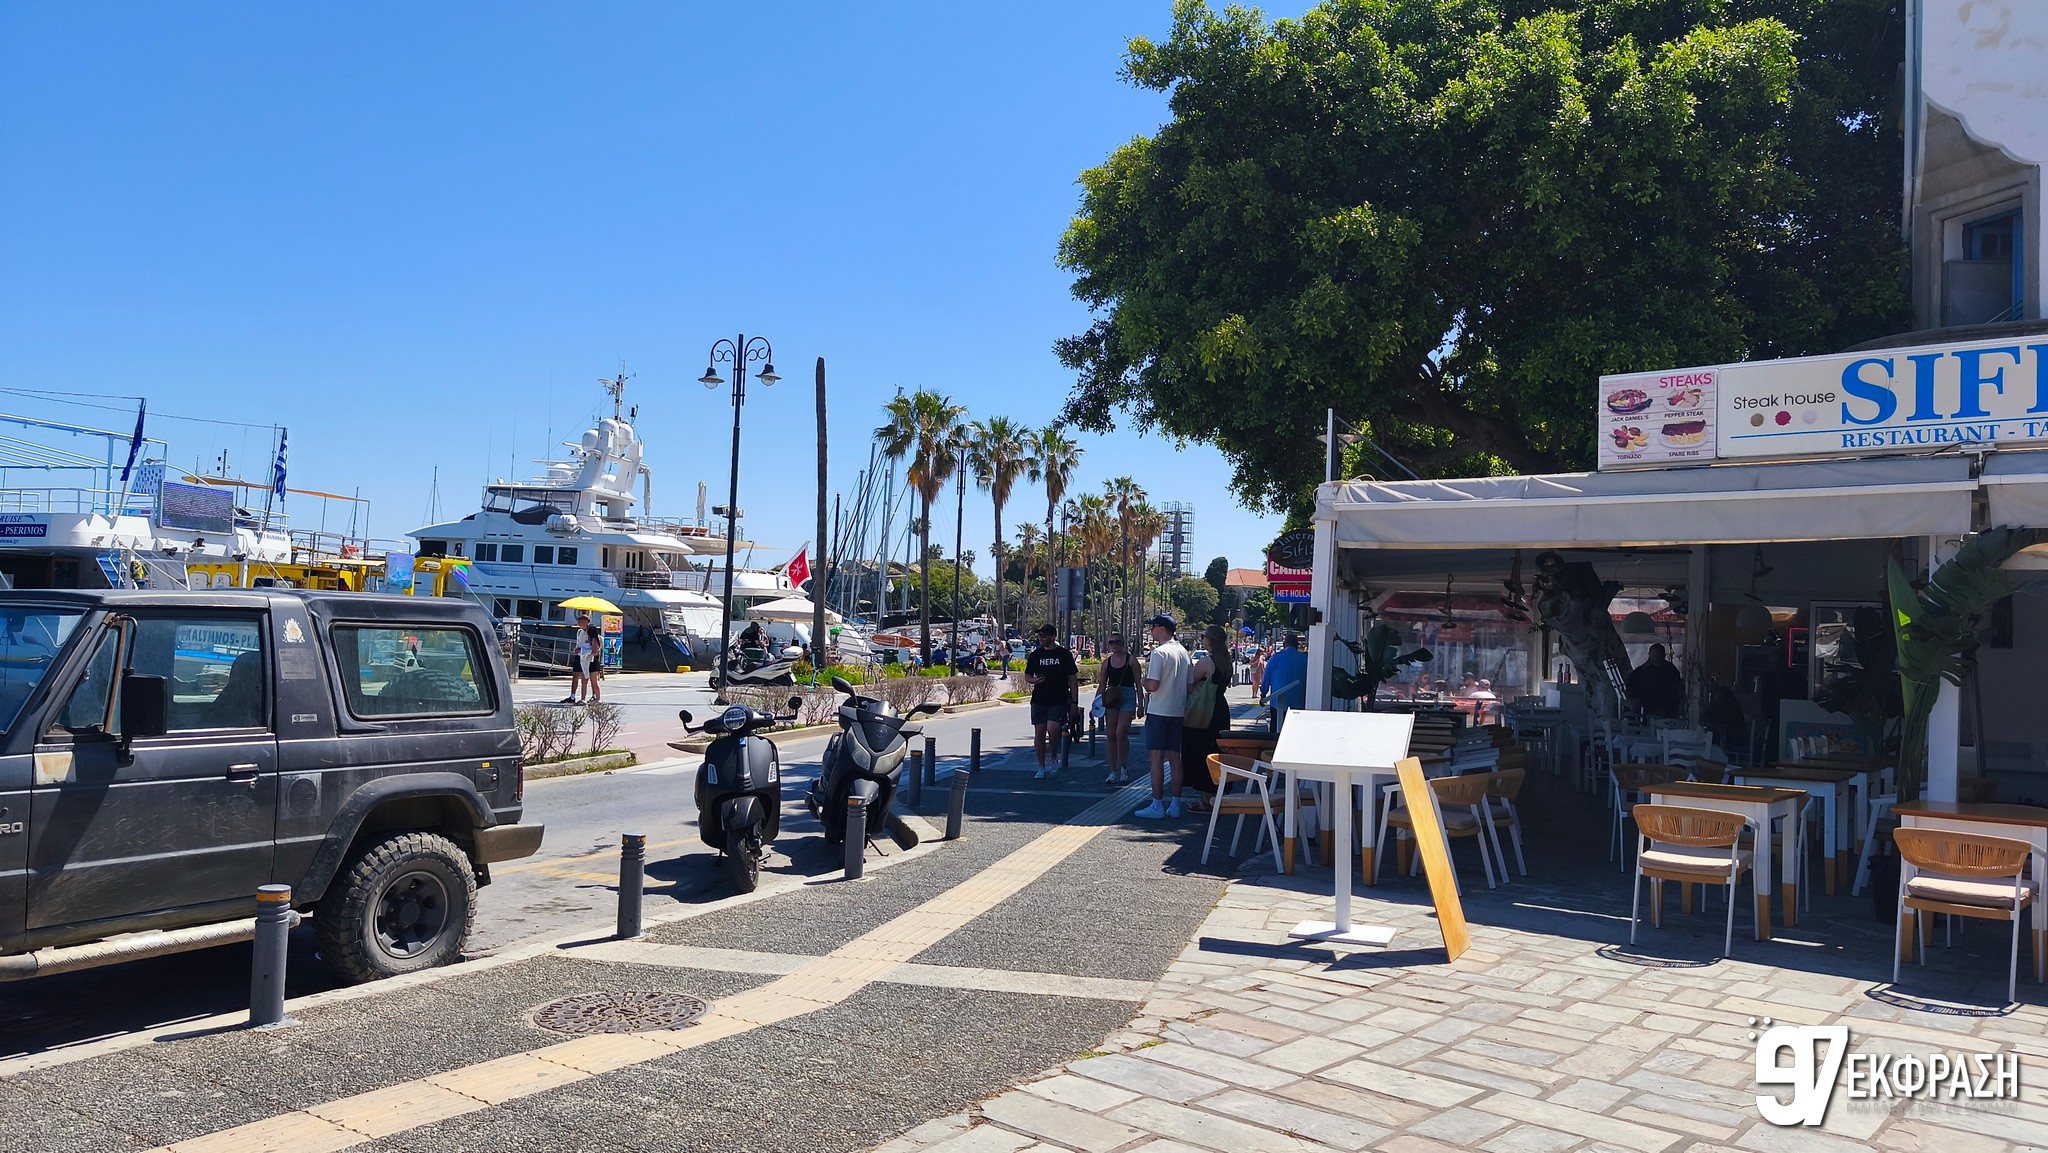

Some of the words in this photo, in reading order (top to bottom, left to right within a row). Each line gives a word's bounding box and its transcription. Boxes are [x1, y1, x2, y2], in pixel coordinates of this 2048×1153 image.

[1659, 373, 1713, 389] STEAKS
[1733, 394, 1779, 410] Steak
[1784, 392, 1836, 406] house
[1841, 424, 2001, 449] RESTAURANT
[1617, 453, 1642, 461] TORNADO
[1039, 657, 1061, 666] HERA
